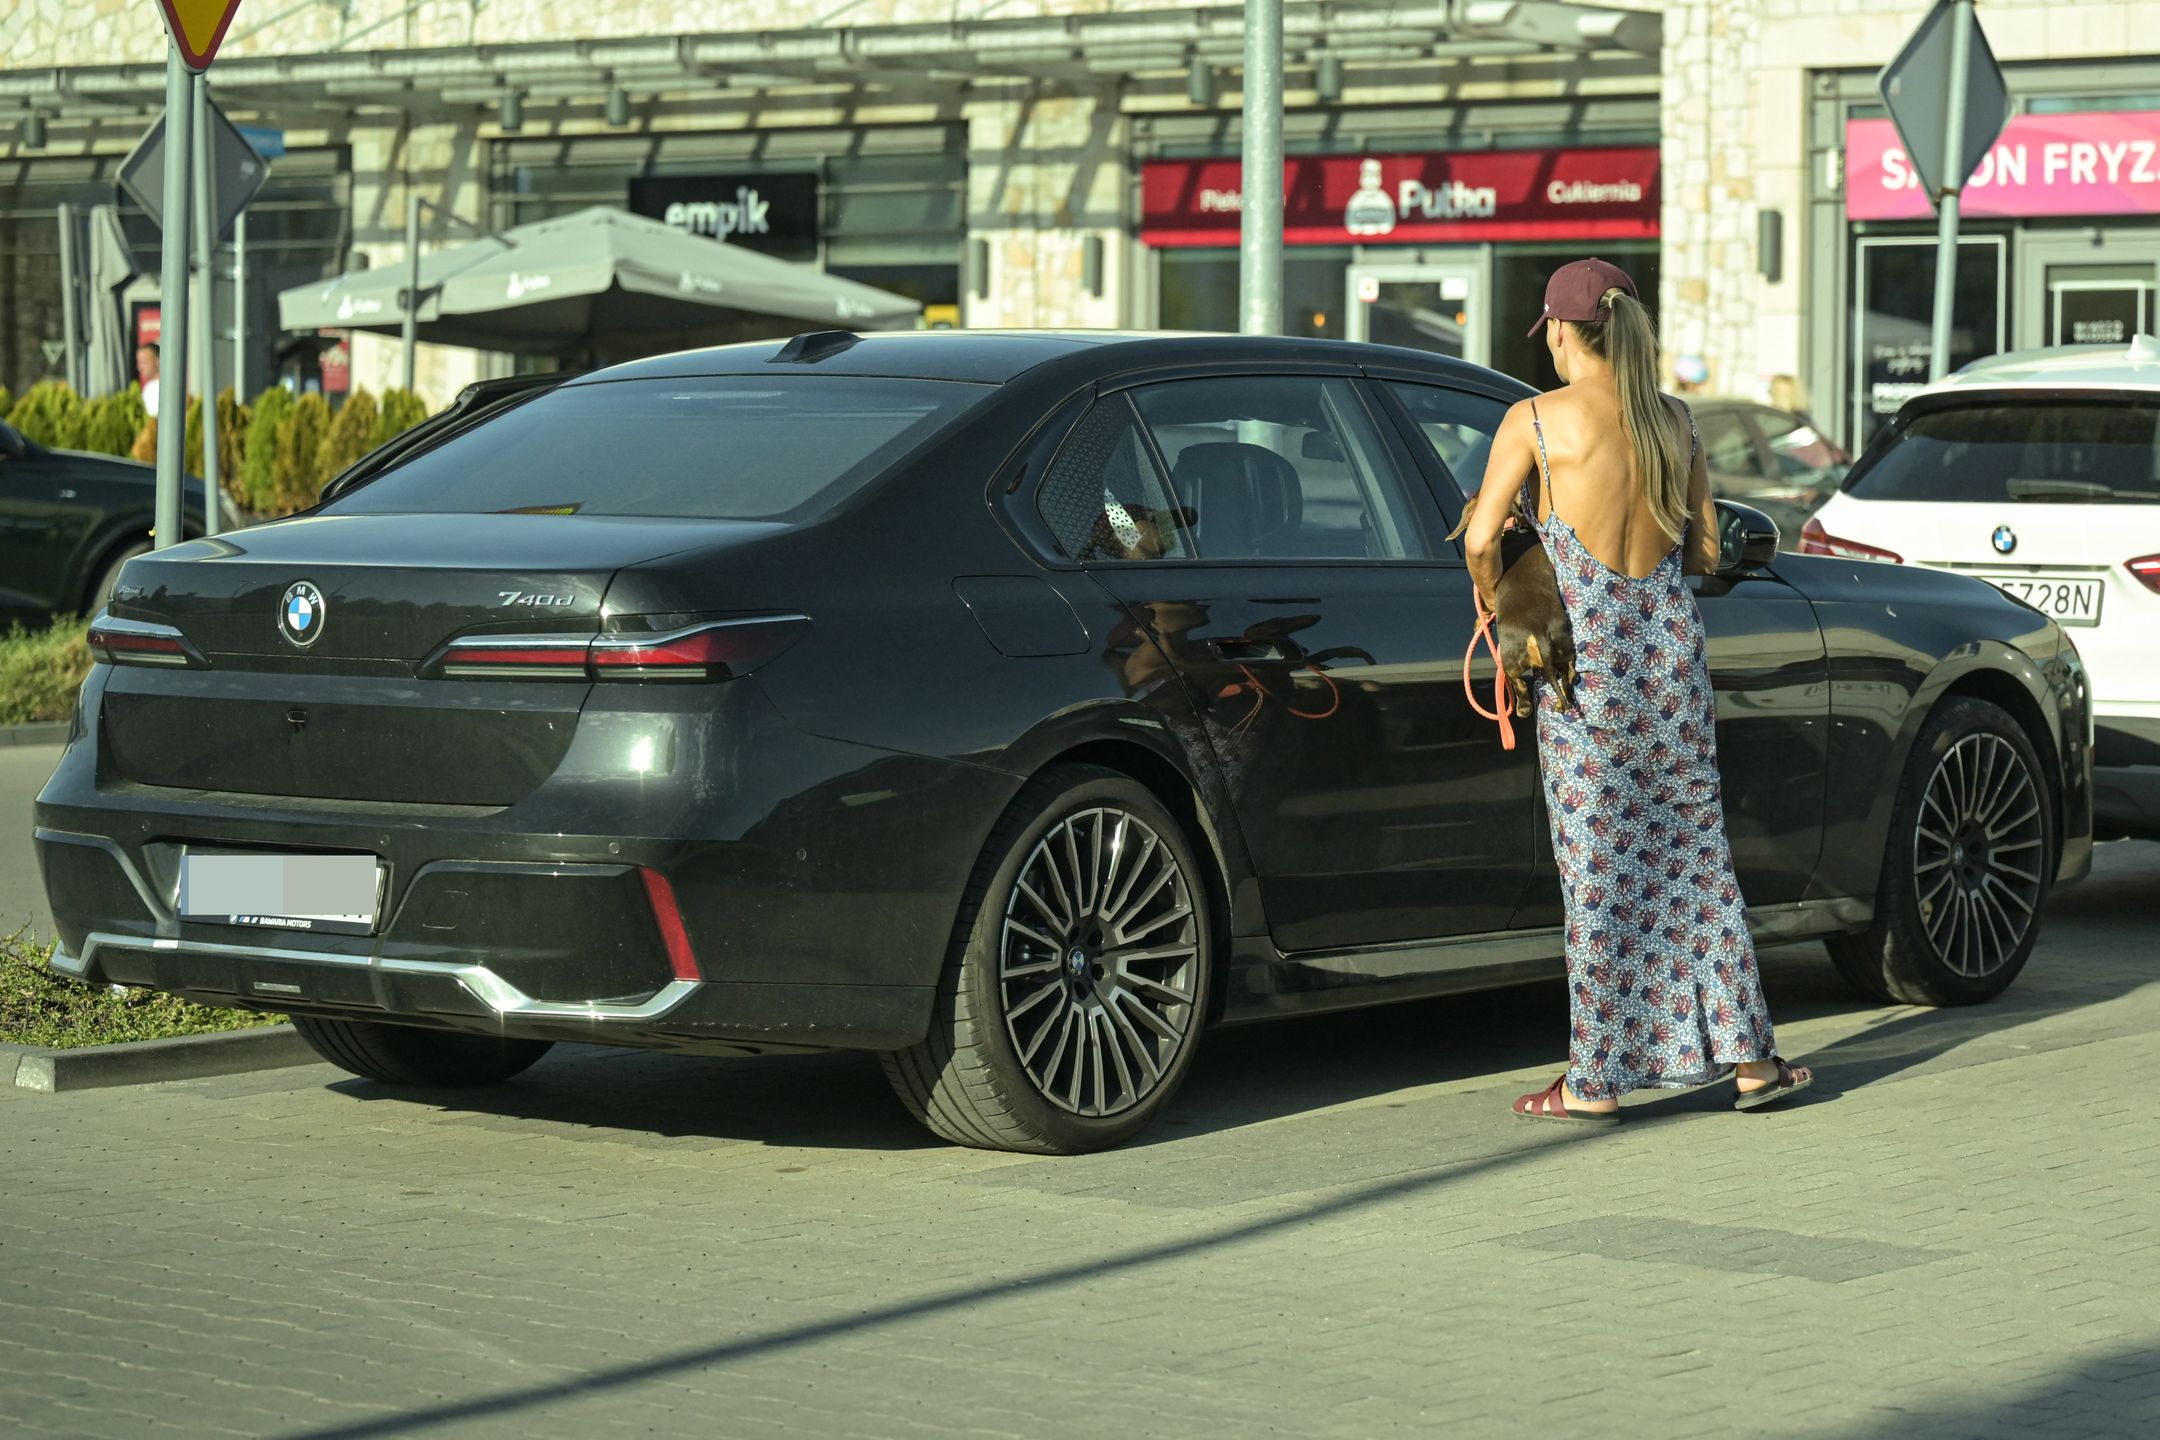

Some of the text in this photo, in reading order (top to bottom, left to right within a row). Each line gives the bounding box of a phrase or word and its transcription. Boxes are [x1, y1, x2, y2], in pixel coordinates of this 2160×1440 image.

[1881, 140, 2160, 190] SON FRYZ
[1399, 179, 1496, 218] Putka
[1547, 179, 1641, 203] Cukiernia
[665, 185, 769, 242] empik
[285, 585, 319, 605] BMW
[498, 591, 575, 606] 740d
[2002, 583, 2092, 614] 728N
[287, 919, 312, 928] MOTORS
